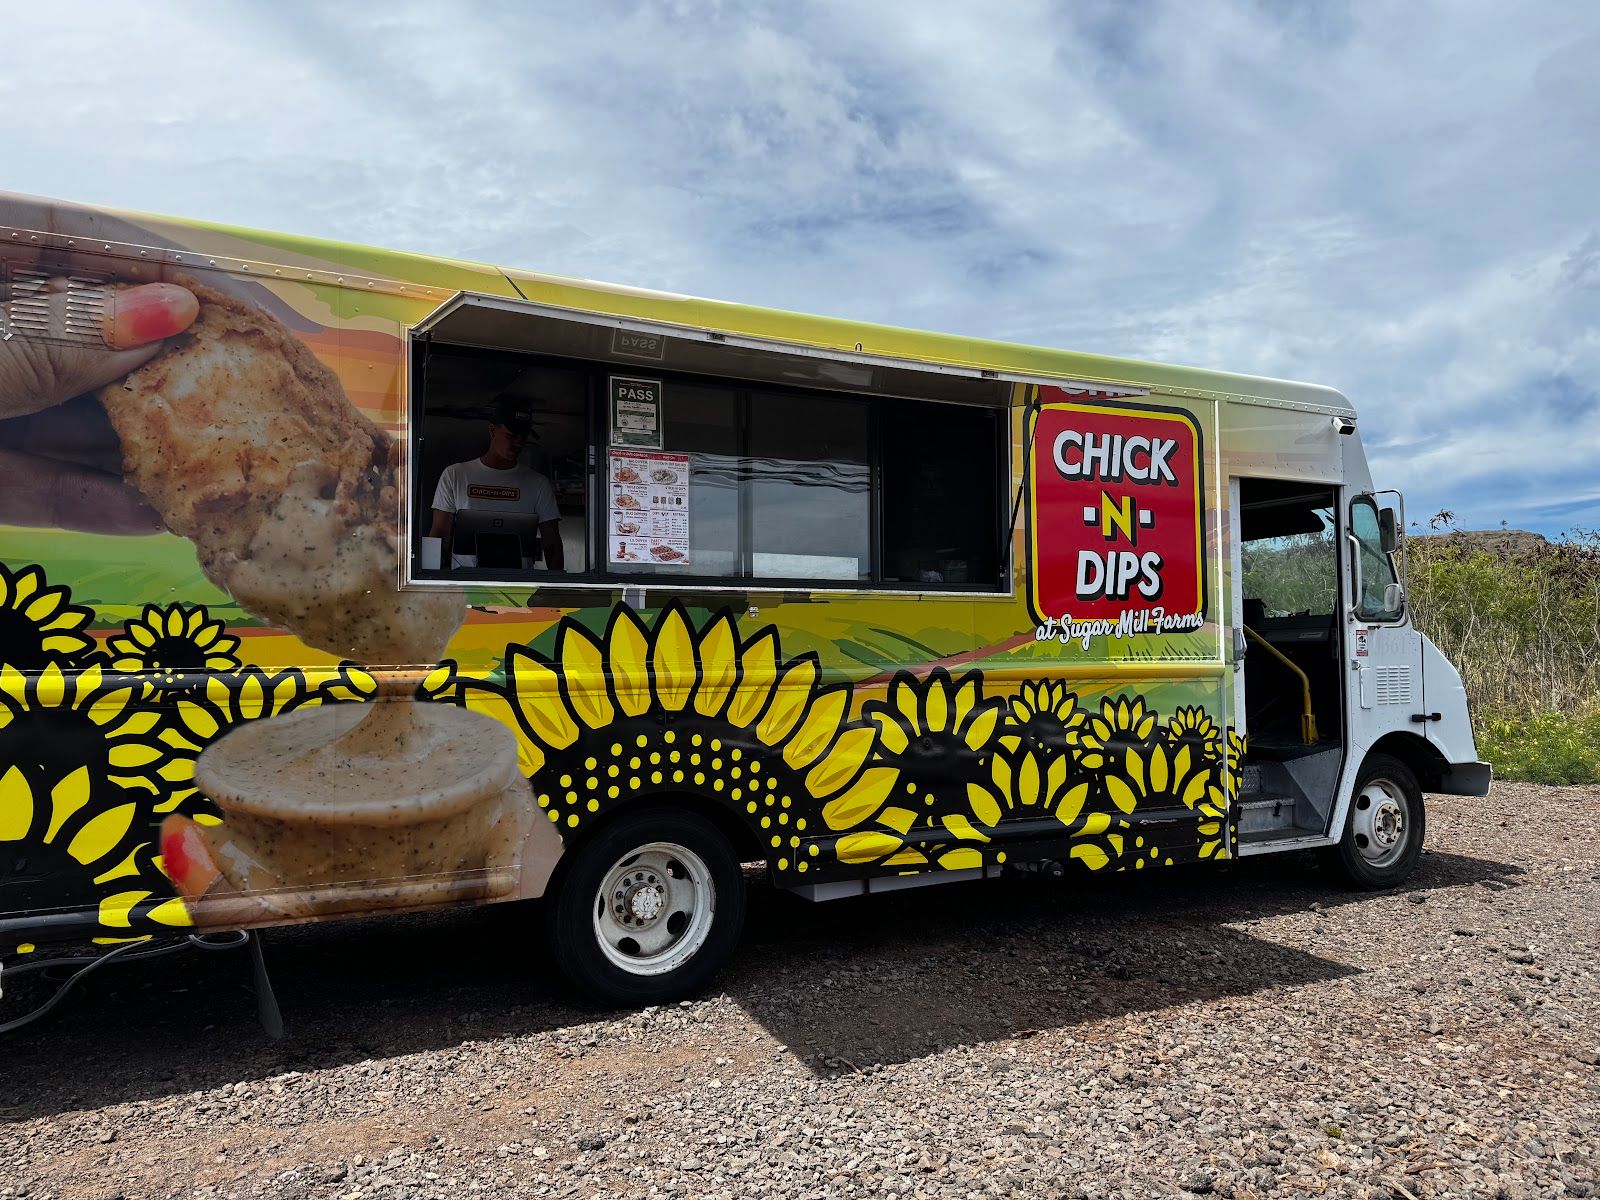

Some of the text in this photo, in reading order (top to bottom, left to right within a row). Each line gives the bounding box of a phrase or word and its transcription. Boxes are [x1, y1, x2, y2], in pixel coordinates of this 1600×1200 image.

[619, 388, 654, 401] PASS
[1053, 429, 1178, 485] CHICK
[1076, 550, 1164, 601] DIPS
[1036, 606, 1205, 650] at Sugar Mill Farms
